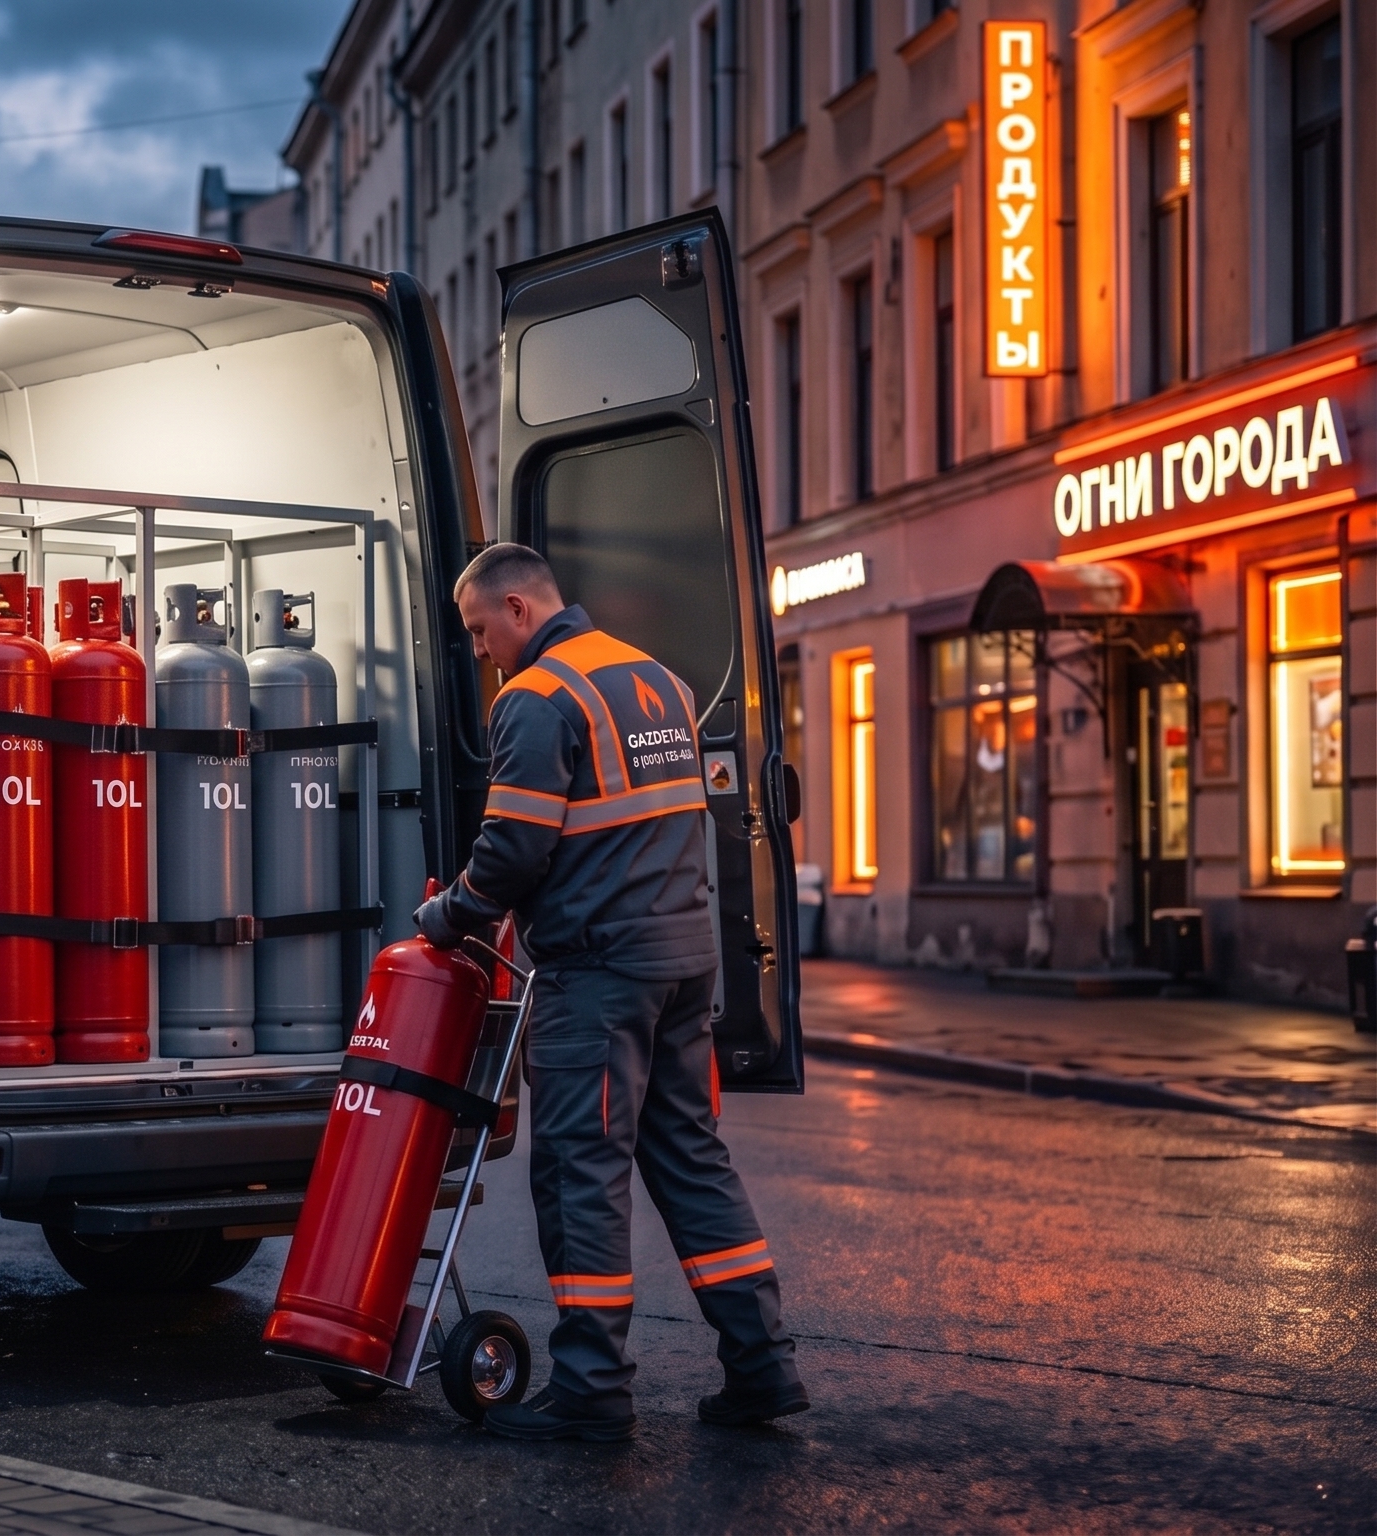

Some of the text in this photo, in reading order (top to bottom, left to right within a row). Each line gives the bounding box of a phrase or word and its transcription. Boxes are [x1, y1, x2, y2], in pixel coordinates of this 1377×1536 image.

[996, 30, 1040, 368] ПРОДУКТЫ
[1054, 397, 1344, 538] ОГНИ ГОРОДА
[627, 727, 692, 749] GAZDETAIL
[92, 779, 143, 808] 10L
[199, 782, 247, 810] 10L
[291, 782, 337, 809] 10L
[335, 1082, 382, 1117] 10L
